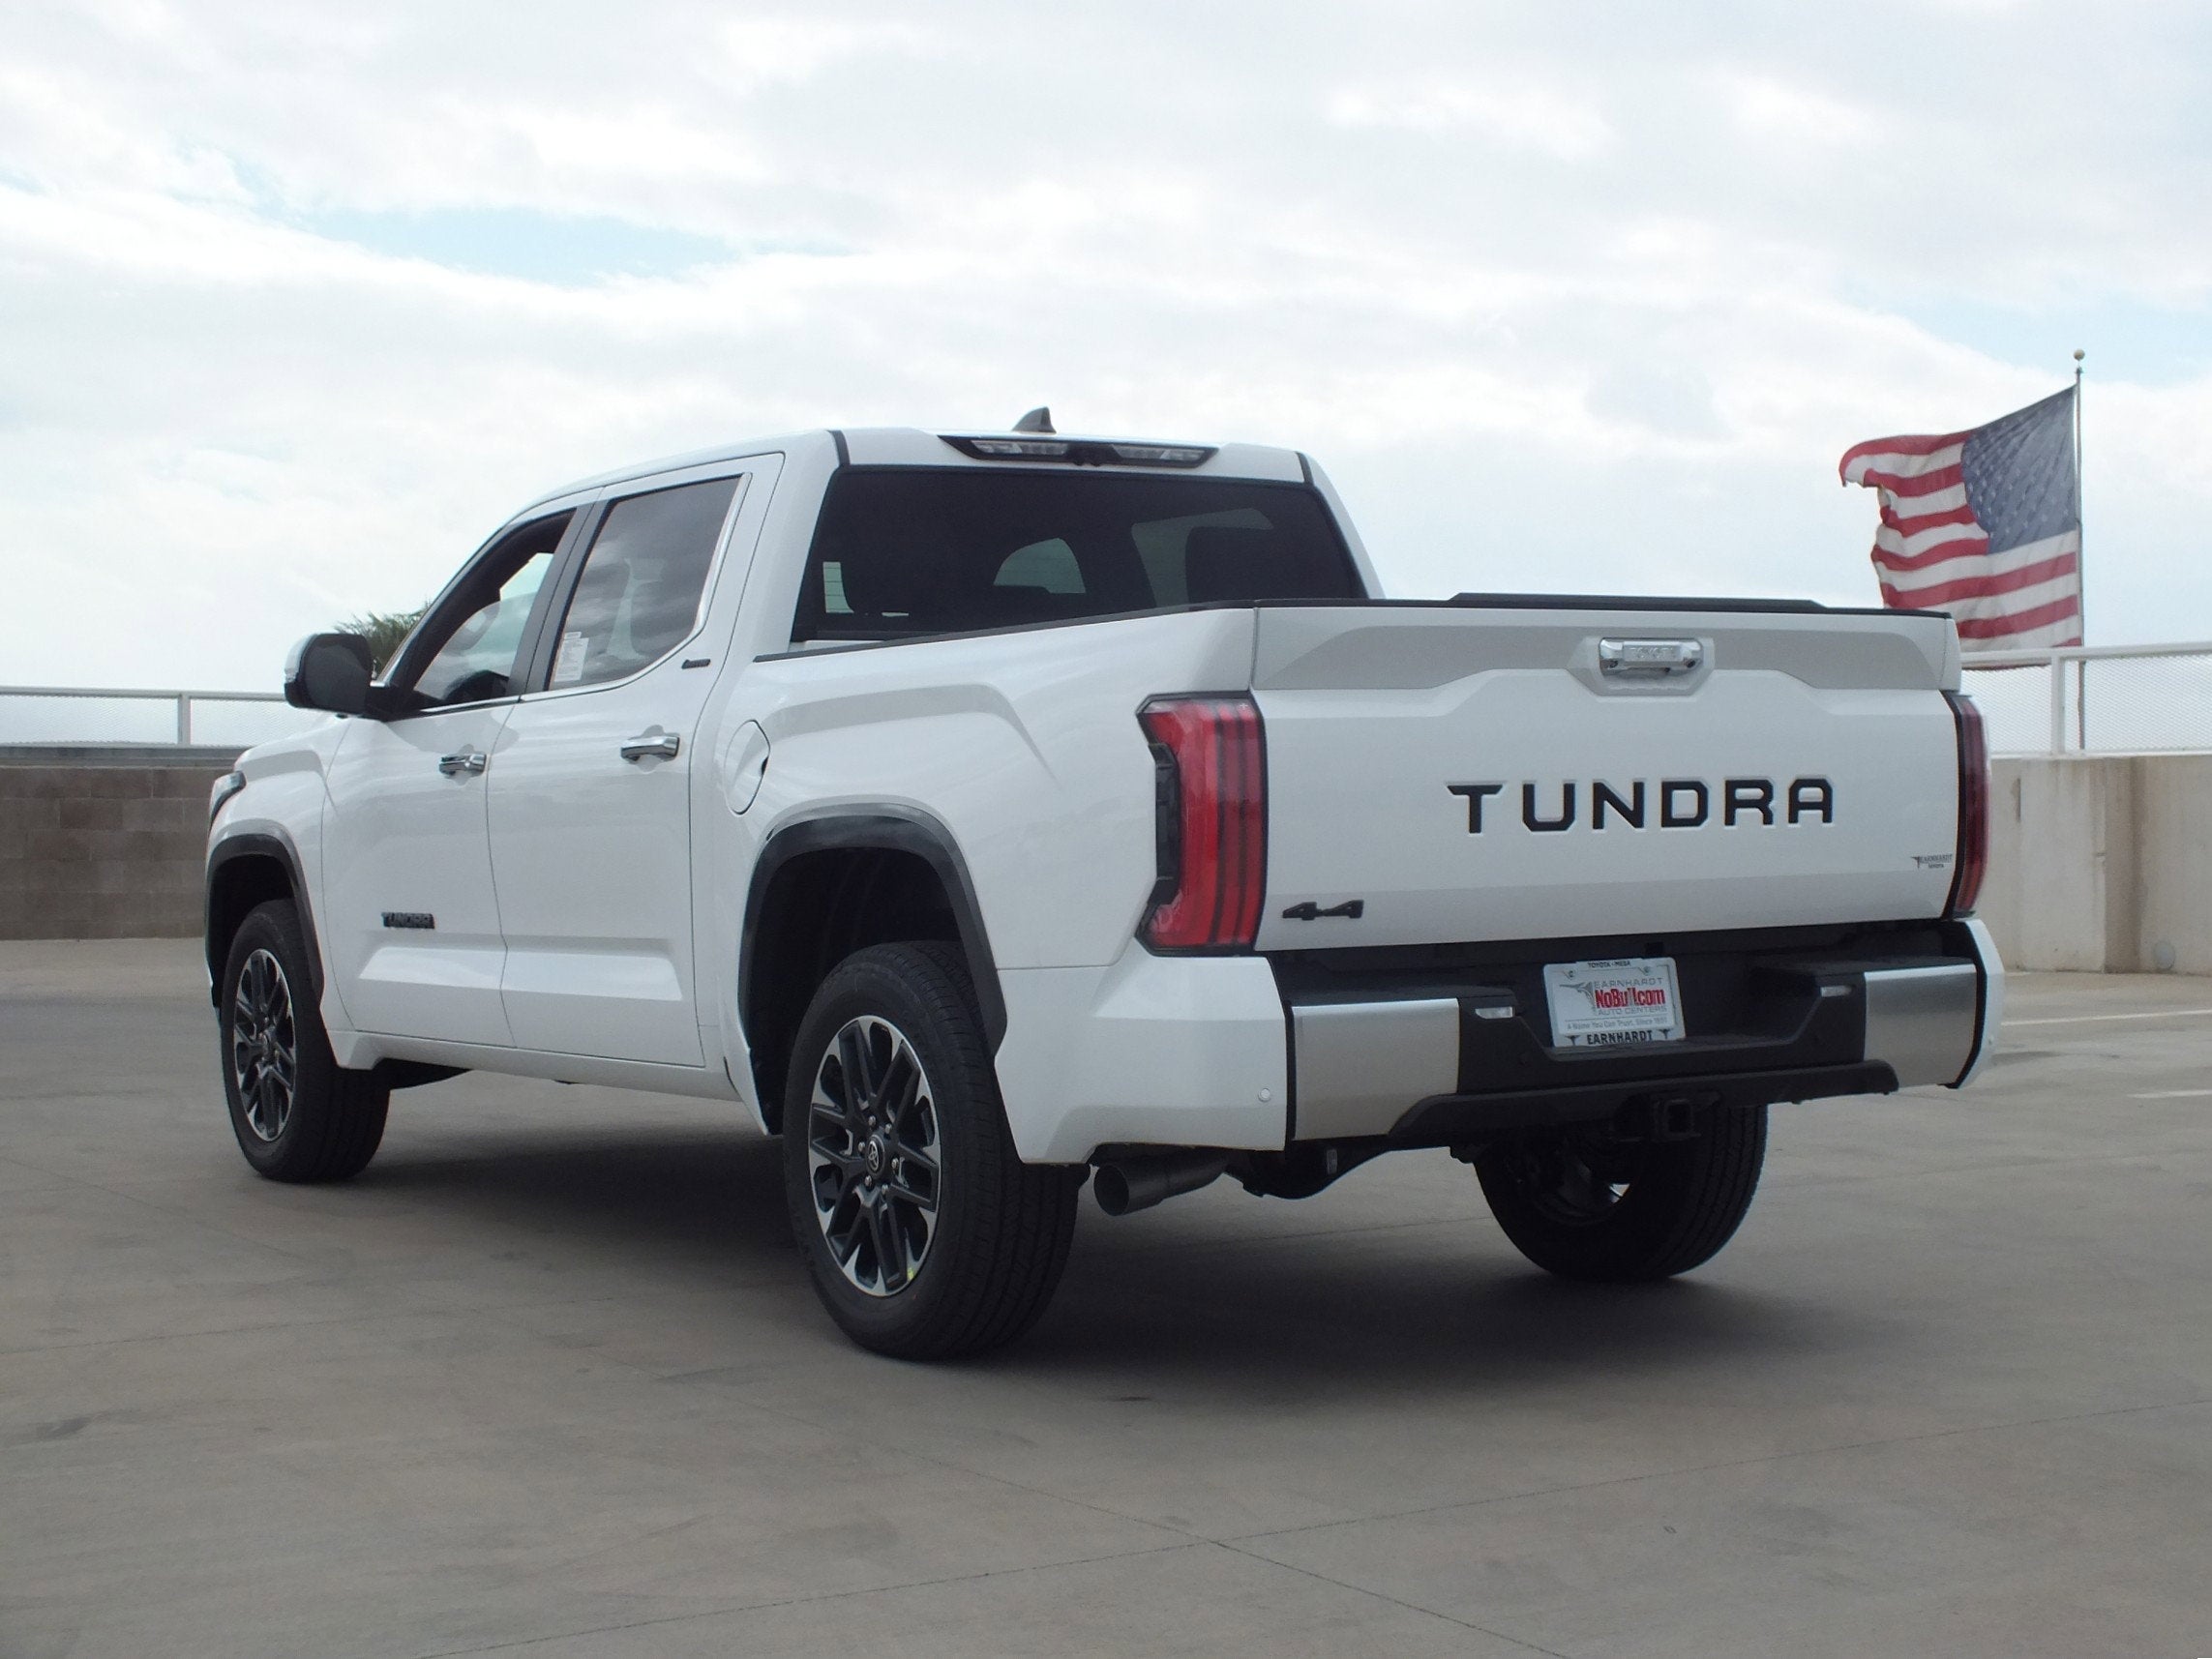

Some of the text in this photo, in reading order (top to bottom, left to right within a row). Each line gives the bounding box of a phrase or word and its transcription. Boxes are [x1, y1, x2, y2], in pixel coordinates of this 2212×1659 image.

[1447, 778, 1835, 834] TUNDRA
[1594, 977, 1663, 989] EARNHARDT
[1625, 1006, 1667, 1015] CENTERS
[1587, 1030, 1653, 1045] EARNHARDT
